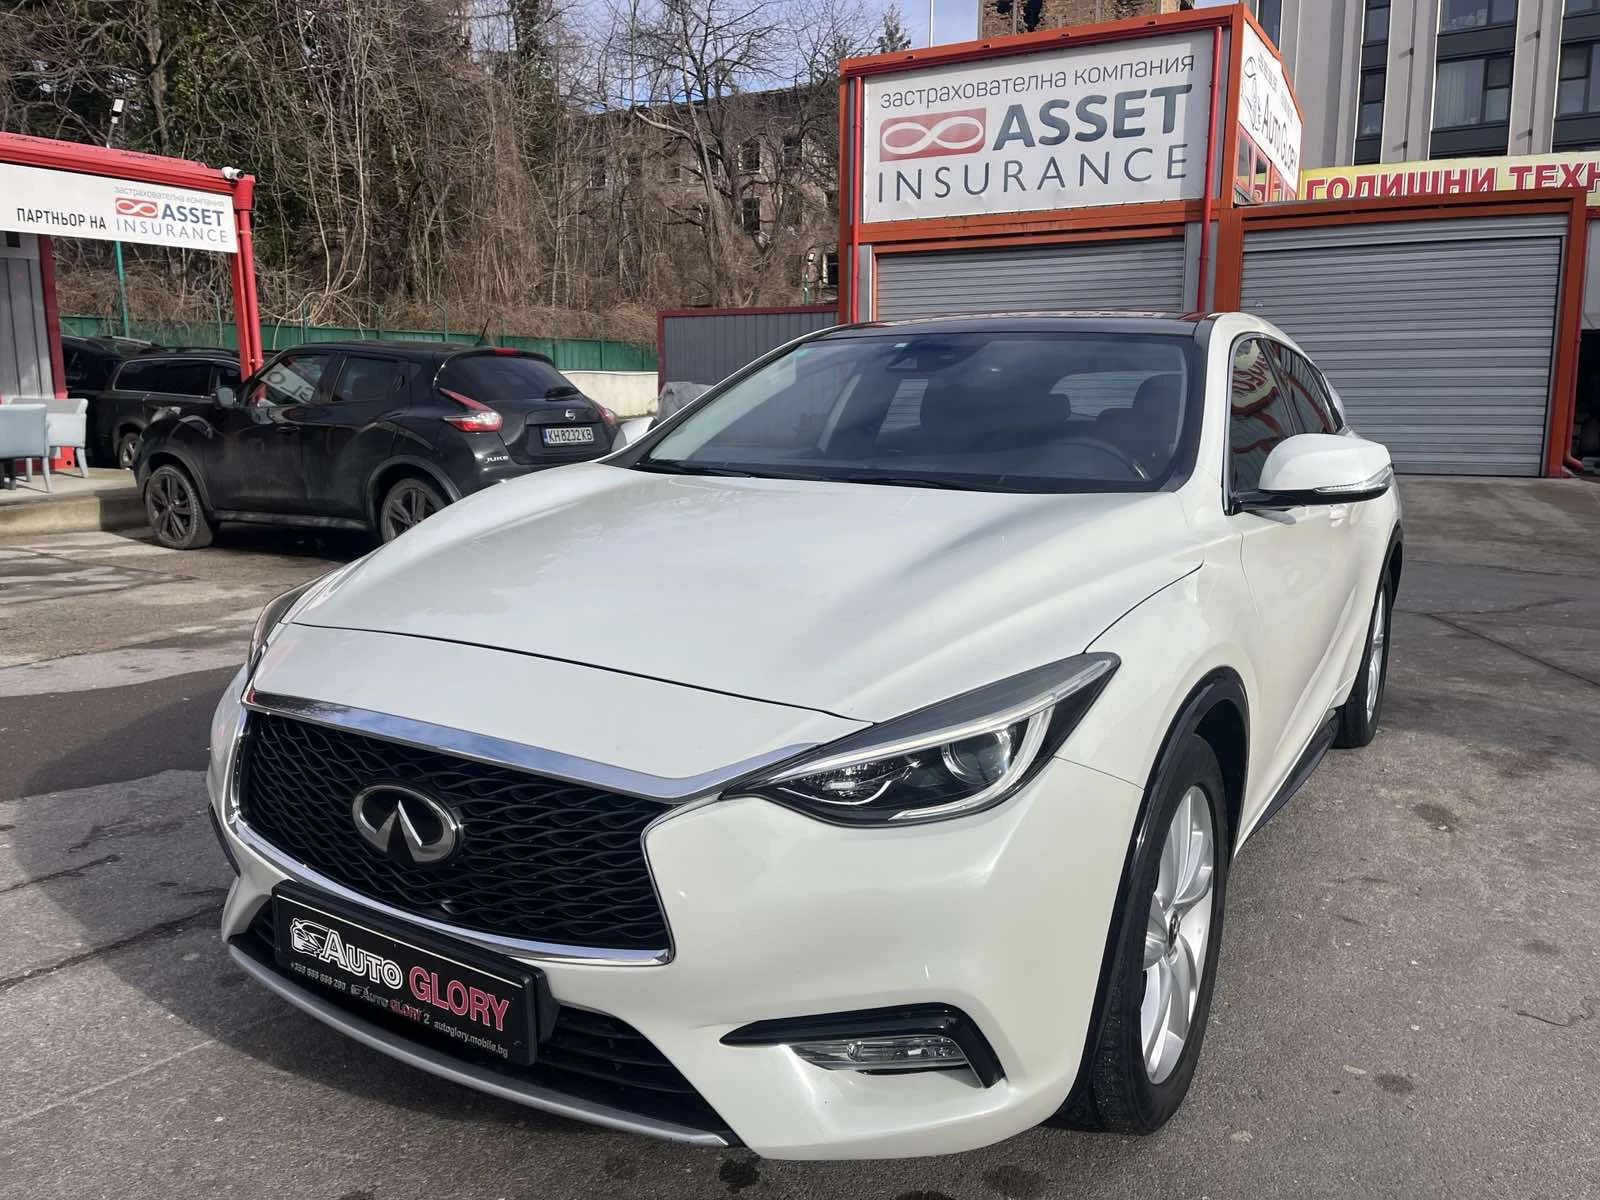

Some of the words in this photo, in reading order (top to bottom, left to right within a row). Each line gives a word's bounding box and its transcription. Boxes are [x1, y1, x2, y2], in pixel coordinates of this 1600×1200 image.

[880, 75, 1067, 109] застрахователна
[1073, 54, 1195, 86] компания
[992, 84, 1193, 151] ASSET
[878, 143, 1189, 203] INSURANCE
[17, 207, 86, 229] ПАРТНЬОР
[90, 217, 107, 230] НА
[116, 218, 228, 243] INSURANCE
[161, 203, 224, 227] ASSET
[408, 965, 509, 1032] GLORY
[423, 1013, 430, 1024] 2
[434, 1021, 508, 1057] autoglory.mobile.bg
